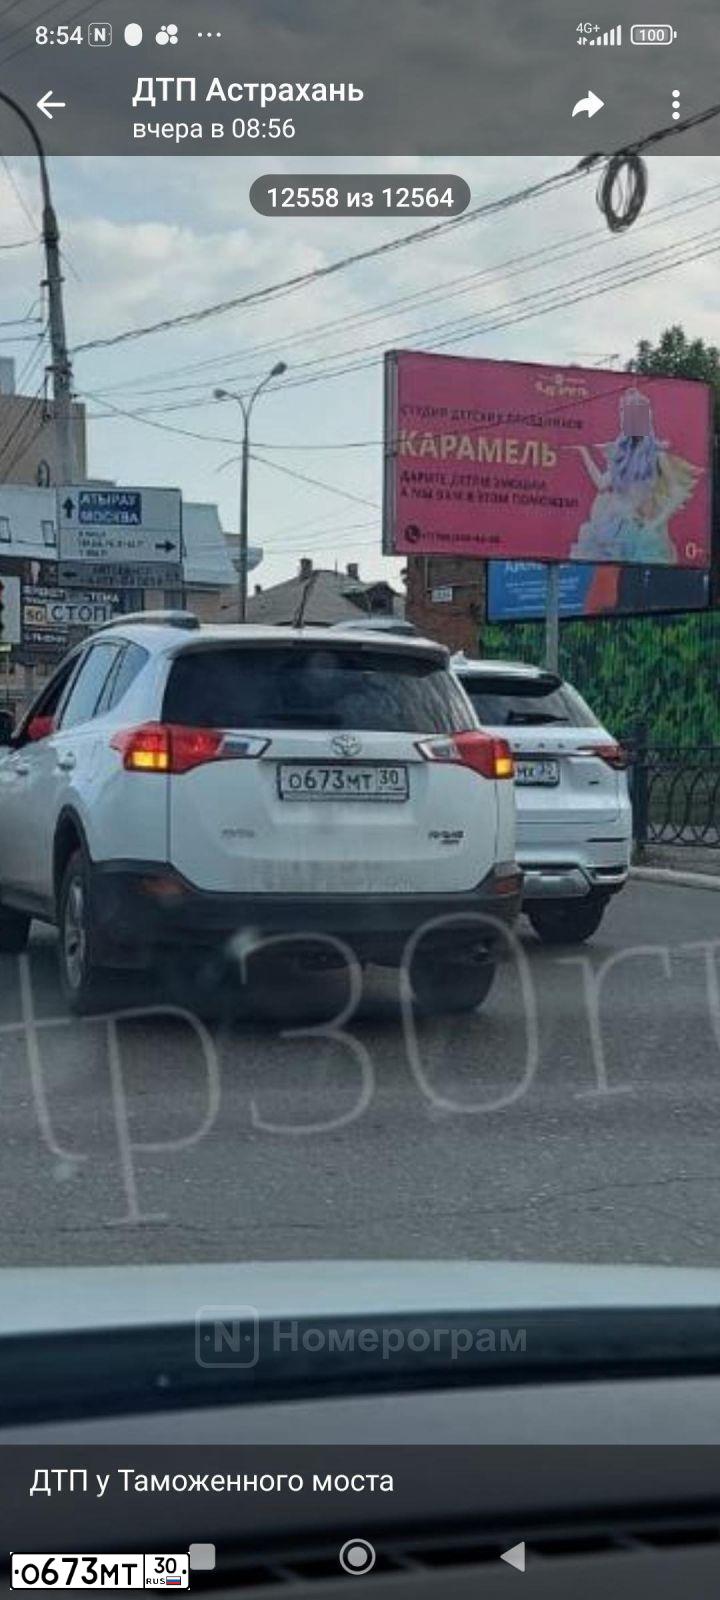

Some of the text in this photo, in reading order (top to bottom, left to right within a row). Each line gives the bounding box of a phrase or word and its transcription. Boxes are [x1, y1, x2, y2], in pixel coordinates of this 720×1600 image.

[397, 430, 557, 467] КАРАМЕЛЬ
[80, 493, 137, 505] АТЫРАУ
[80, 510, 139, 524] МОСКВА
[51, 605, 107, 622] СТОП
[288, 769, 399, 789] О673МТ 30
